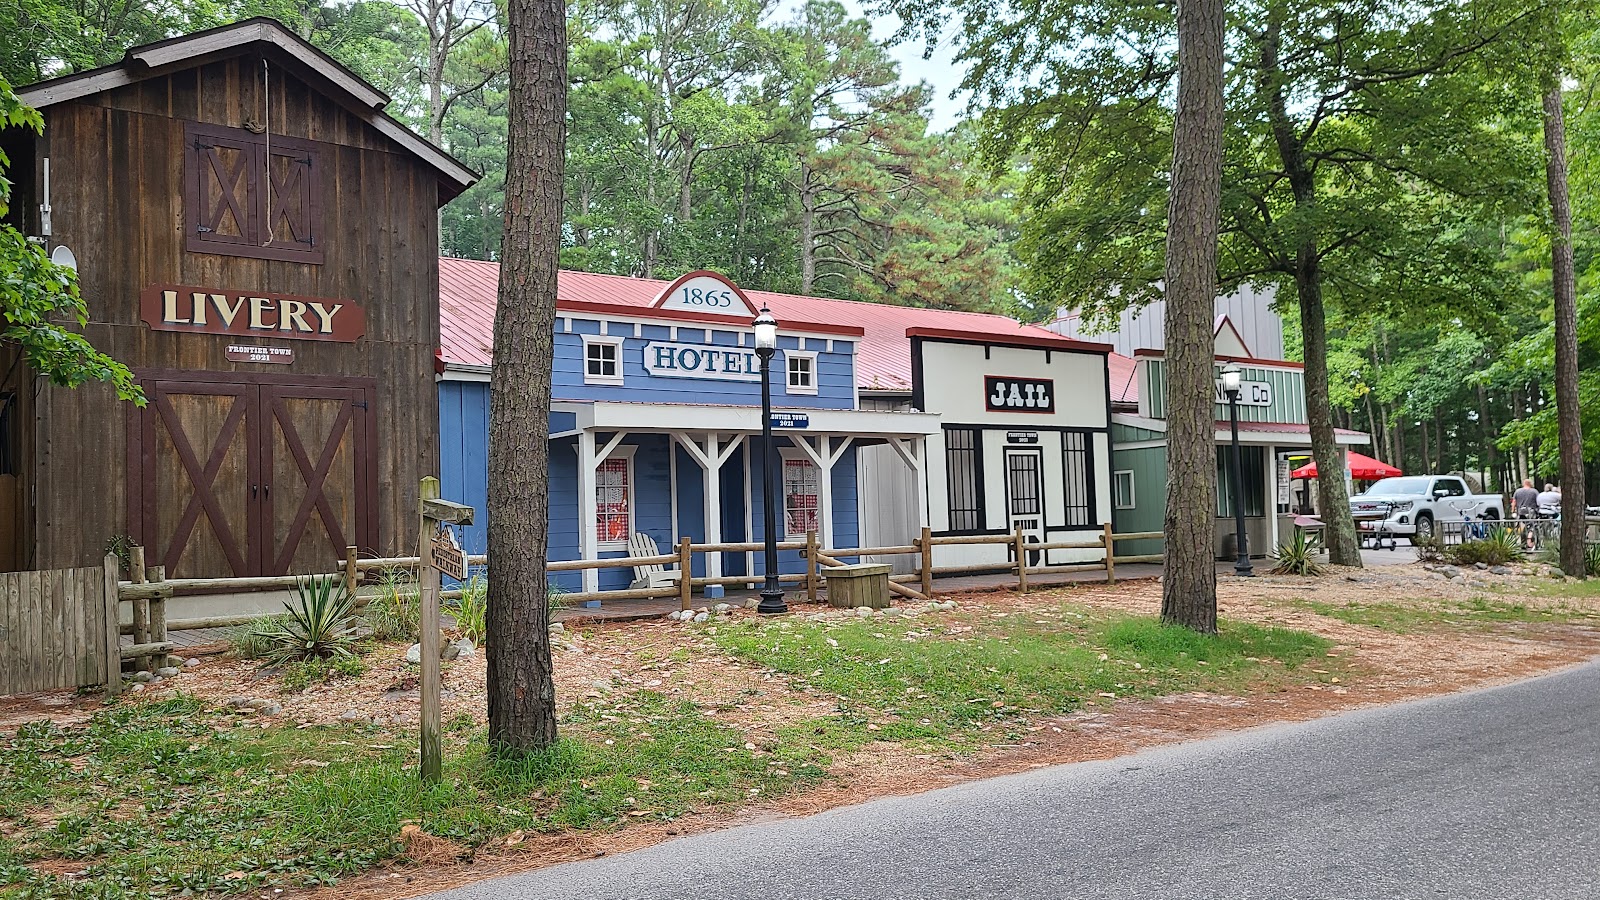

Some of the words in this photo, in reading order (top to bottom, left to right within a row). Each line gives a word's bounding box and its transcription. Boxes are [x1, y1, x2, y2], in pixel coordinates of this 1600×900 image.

[682, 287, 731, 308] 1865
[162, 290, 343, 334] LIVERY
[228, 346, 268, 354] FRONTIER
[652, 346, 761, 375] HOTEL
[990, 382, 1050, 408] JAIL
